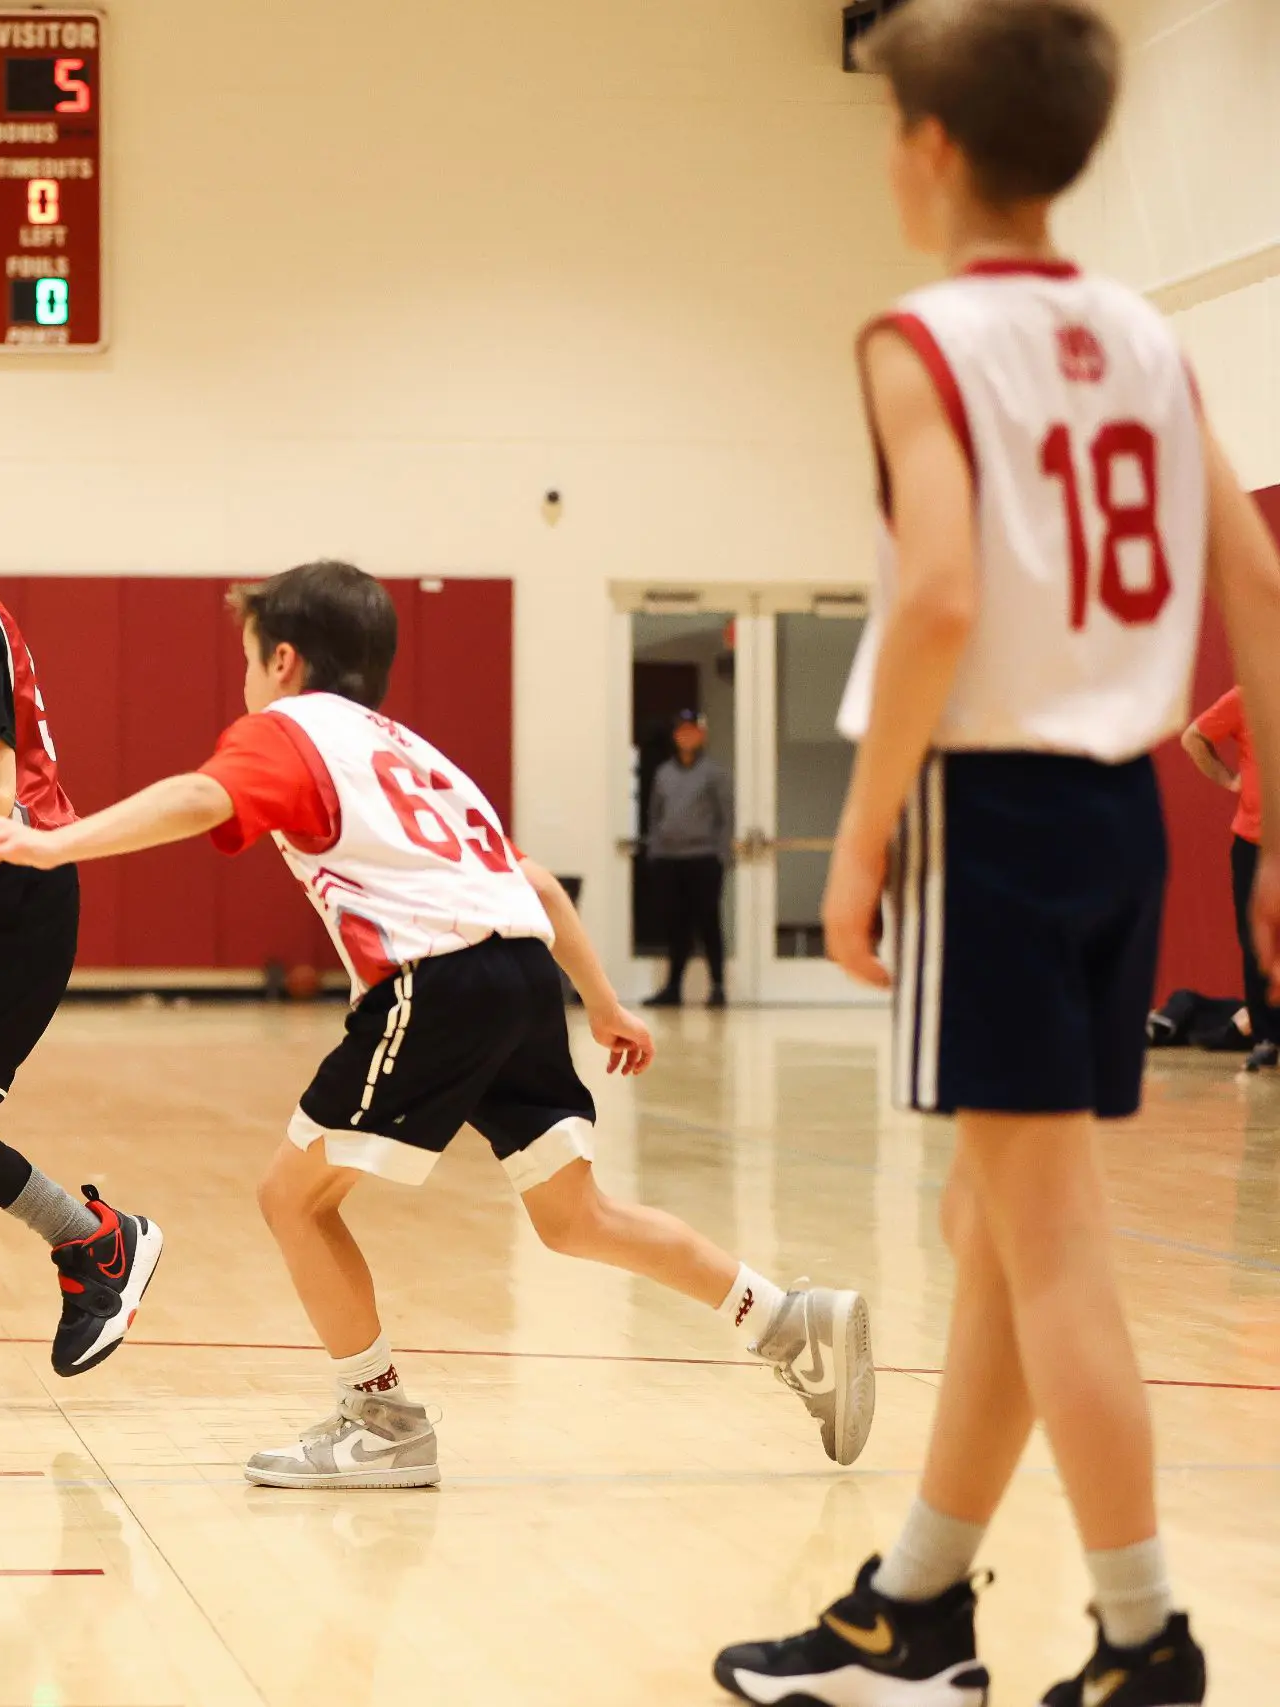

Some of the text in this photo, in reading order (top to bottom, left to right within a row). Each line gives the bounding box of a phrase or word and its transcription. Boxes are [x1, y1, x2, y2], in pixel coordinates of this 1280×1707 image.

[54, 58, 90, 112] 5
[27, 178, 59, 224] 0
[19, 225, 68, 248] LEFT
[6, 255, 69, 278] FOULS
[35, 277, 69, 326] 0
[1040, 419, 1173, 633] 18
